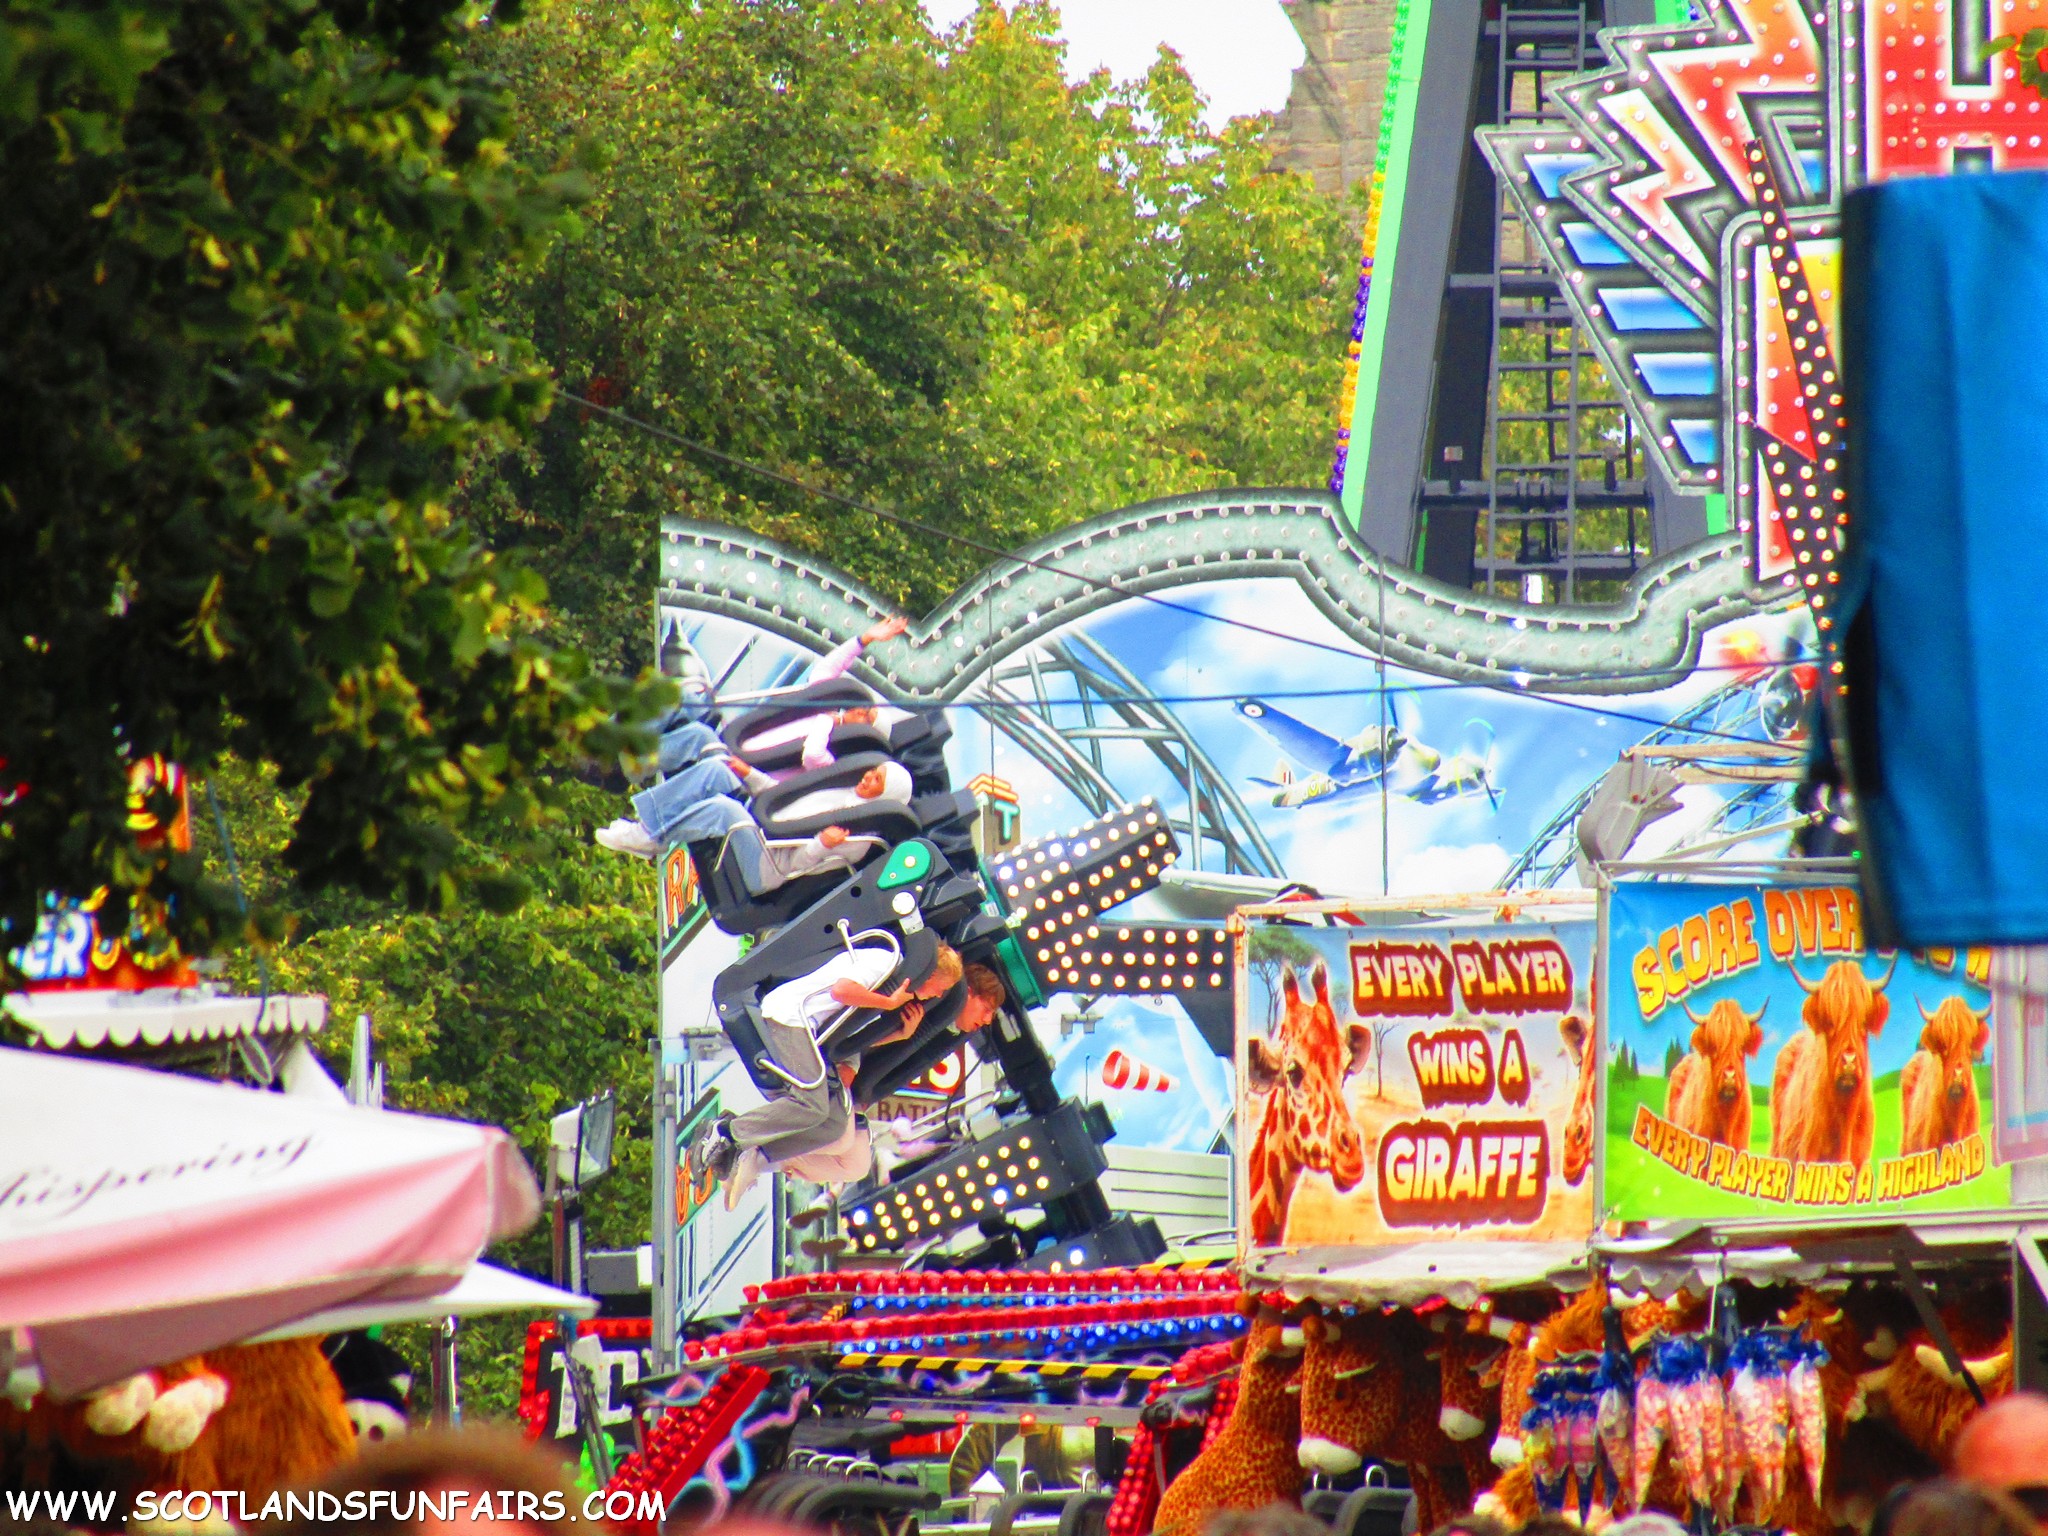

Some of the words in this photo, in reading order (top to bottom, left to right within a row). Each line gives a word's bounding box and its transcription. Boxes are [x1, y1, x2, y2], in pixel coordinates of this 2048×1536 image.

[1353, 952, 1446, 1000] EVERY
[1453, 948, 1569, 998] PLAYER
[1632, 896, 1760, 1022] SCORE
[1763, 886, 1866, 960] OVER
[1411, 1037, 1489, 1088] WINS
[1500, 1036, 1526, 1087] A
[0, 1132, 316, 1218] hispering
[1382, 1133, 1544, 1203] GIRAFFE
[1632, 1103, 1709, 1182] EVERY
[1707, 1141, 1791, 1204] PLAYER
[1793, 1162, 1854, 1206] WINS
[1855, 1160, 1873, 1206] A
[1876, 1132, 1987, 1205] HIGHLAND
